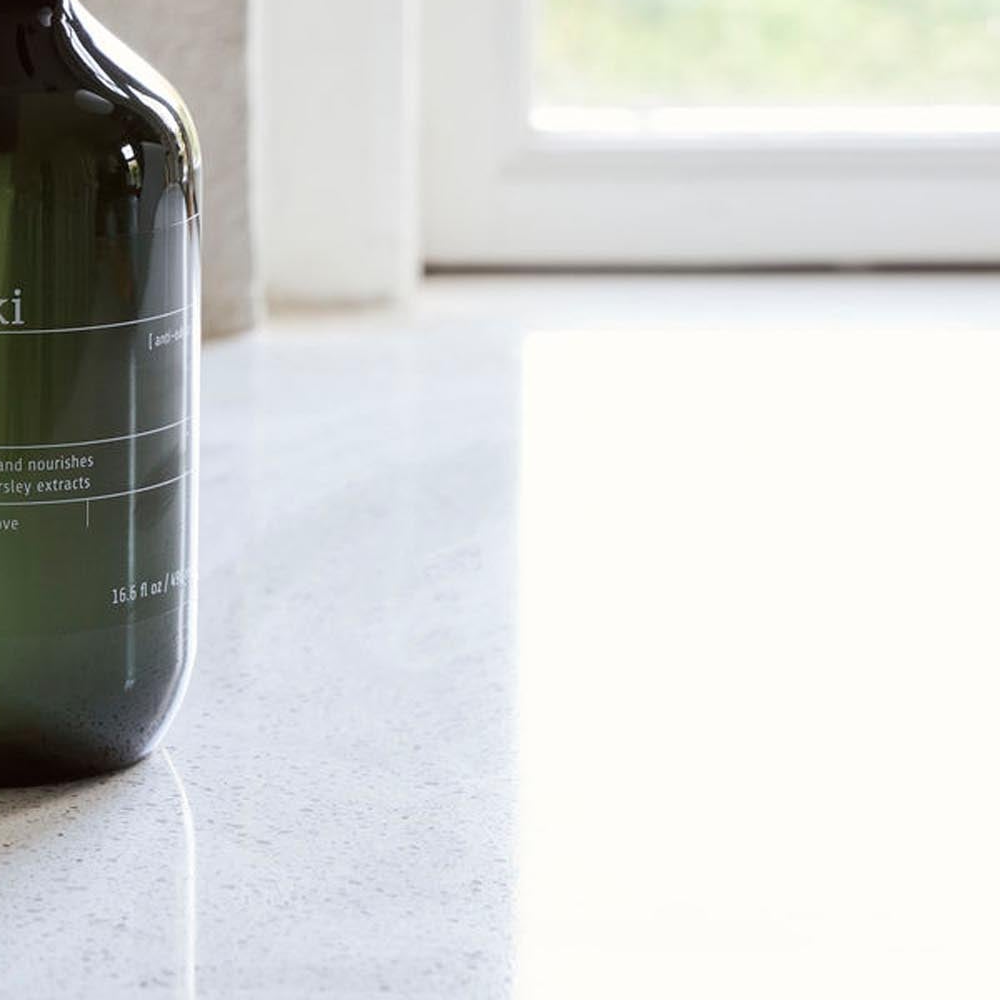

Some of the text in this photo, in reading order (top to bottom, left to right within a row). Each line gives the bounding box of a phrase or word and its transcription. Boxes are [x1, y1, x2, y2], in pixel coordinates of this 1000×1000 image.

[28, 454, 94, 471] nourishes
[36, 476, 91, 493] extracts
[112, 584, 137, 604] 16.6
